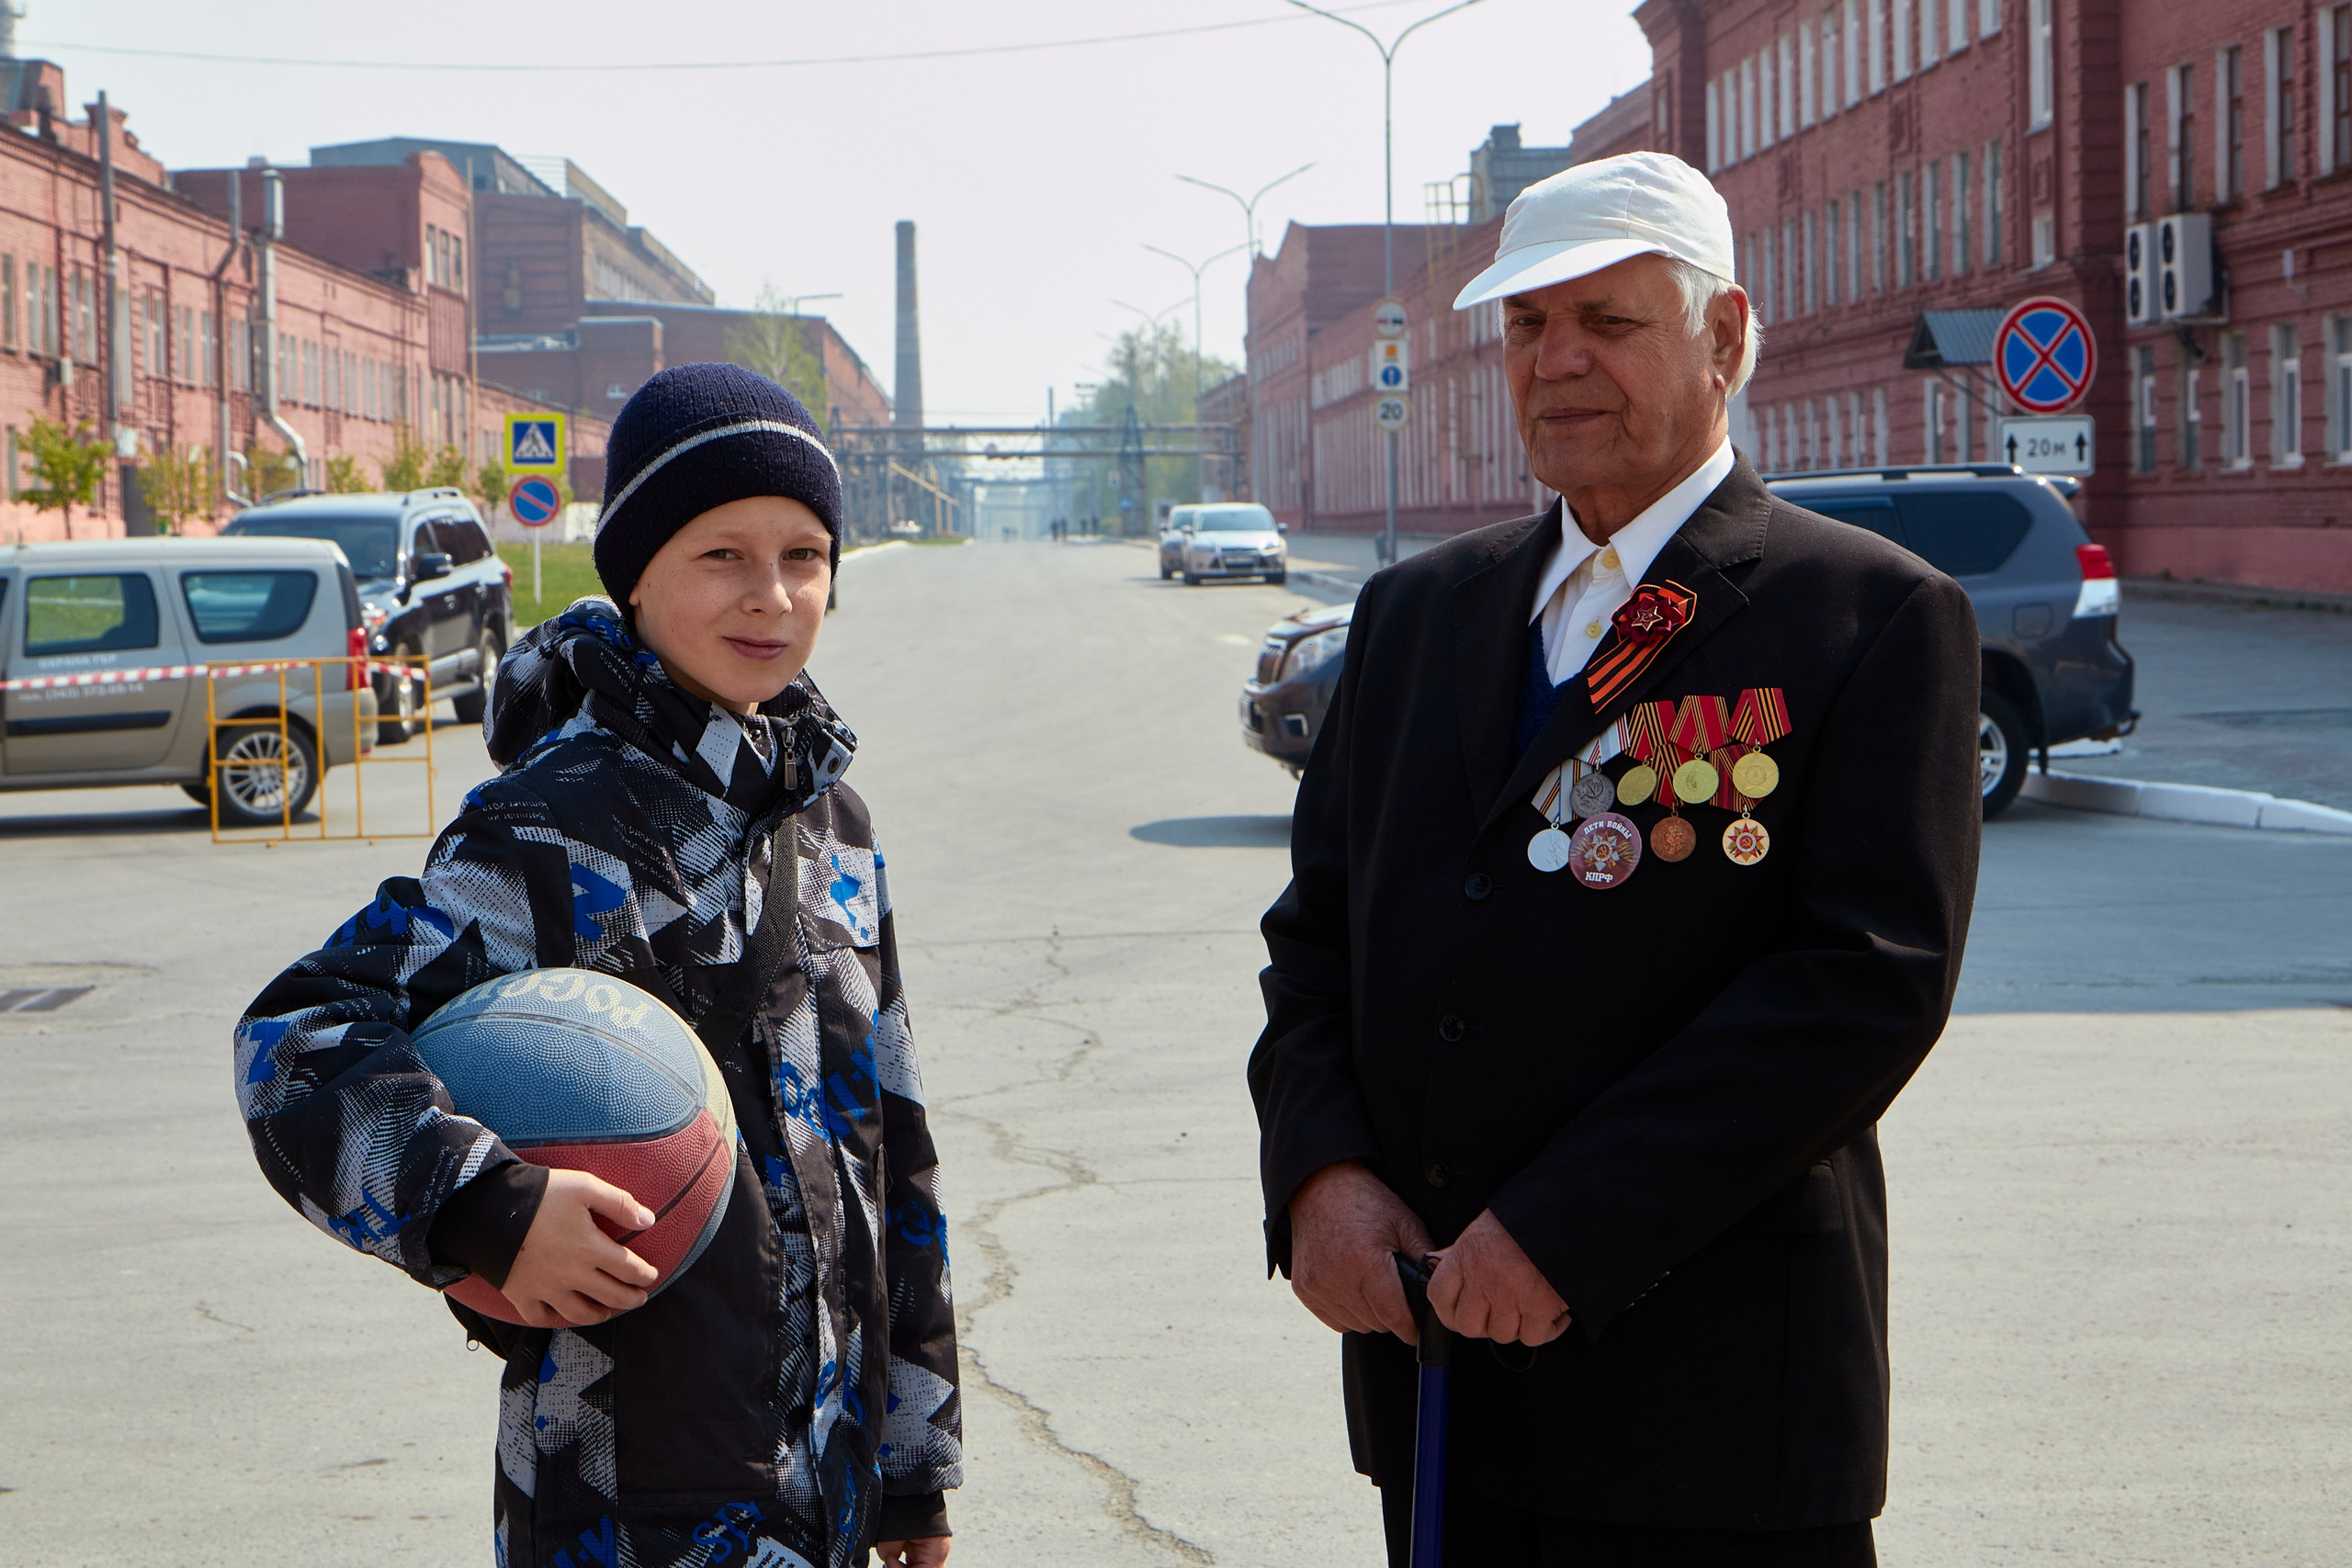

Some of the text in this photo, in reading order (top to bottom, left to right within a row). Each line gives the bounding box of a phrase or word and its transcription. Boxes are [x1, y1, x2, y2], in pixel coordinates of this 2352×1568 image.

[1381, 402, 1403, 420] 20
[1583, 820, 1632, 840] ДЕТИ ВОЙНЫ
[1585, 871, 1613, 883] КПРФ
